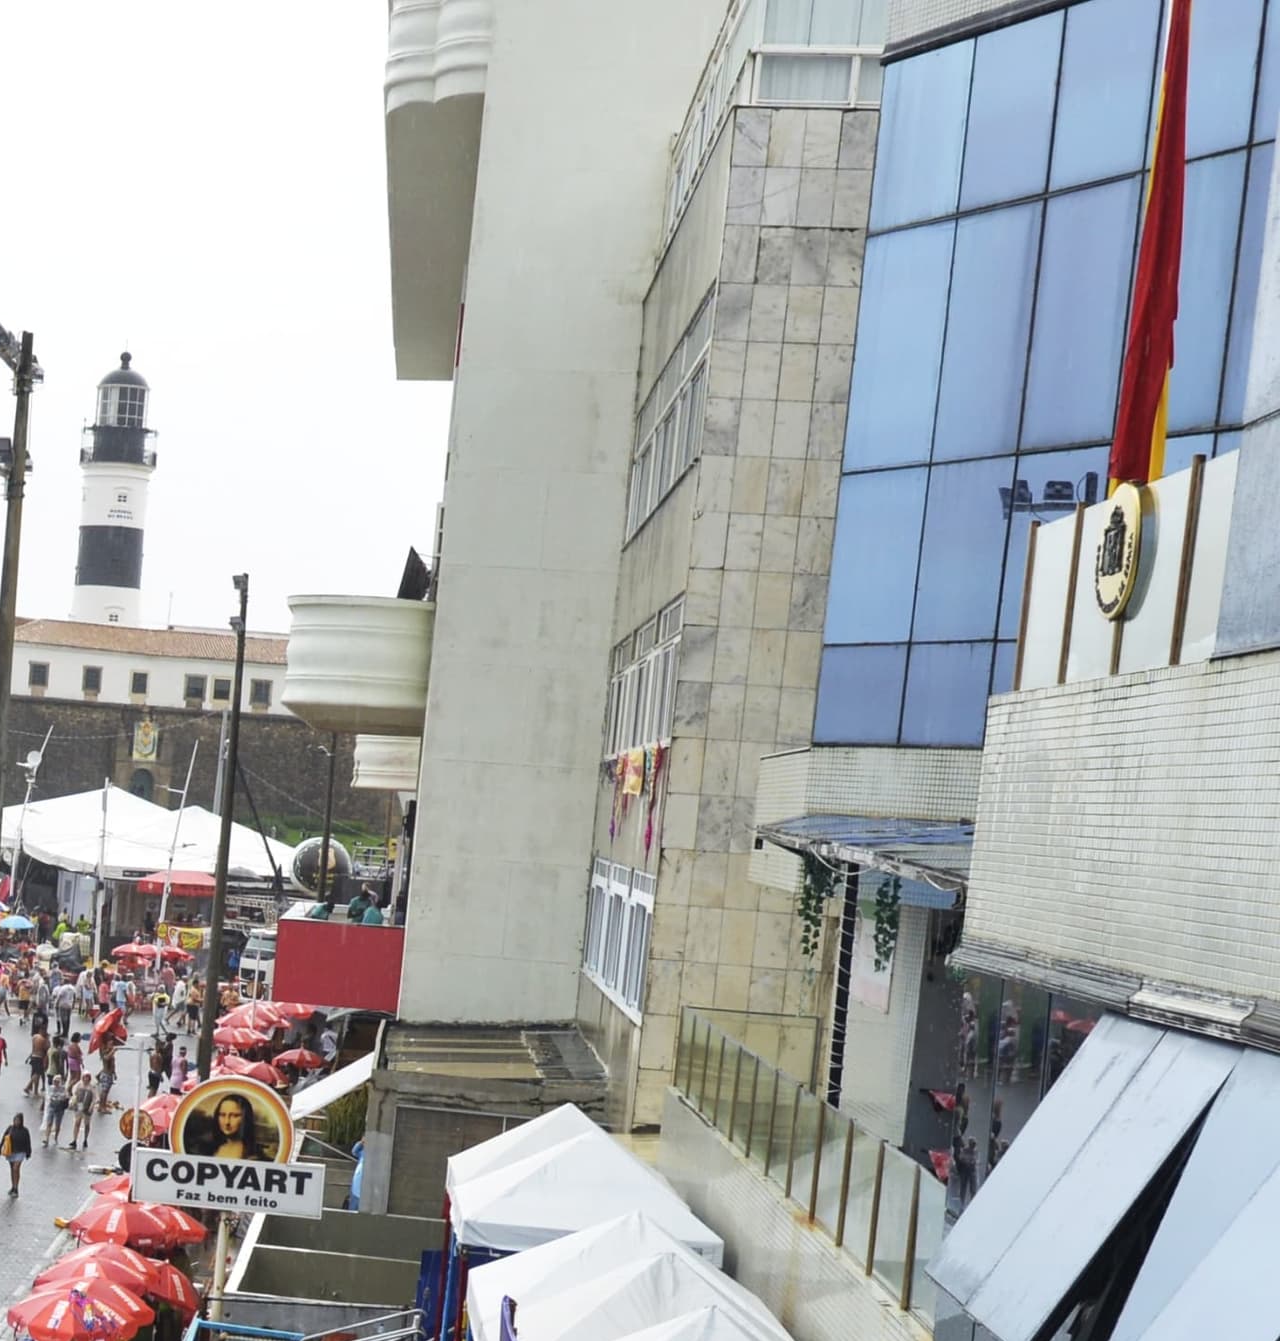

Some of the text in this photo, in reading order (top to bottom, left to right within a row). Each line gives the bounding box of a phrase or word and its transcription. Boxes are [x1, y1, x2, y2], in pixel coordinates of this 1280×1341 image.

[146, 1158, 312, 1195] COPYART
[176, 1189, 278, 1208] Faz bem feito
